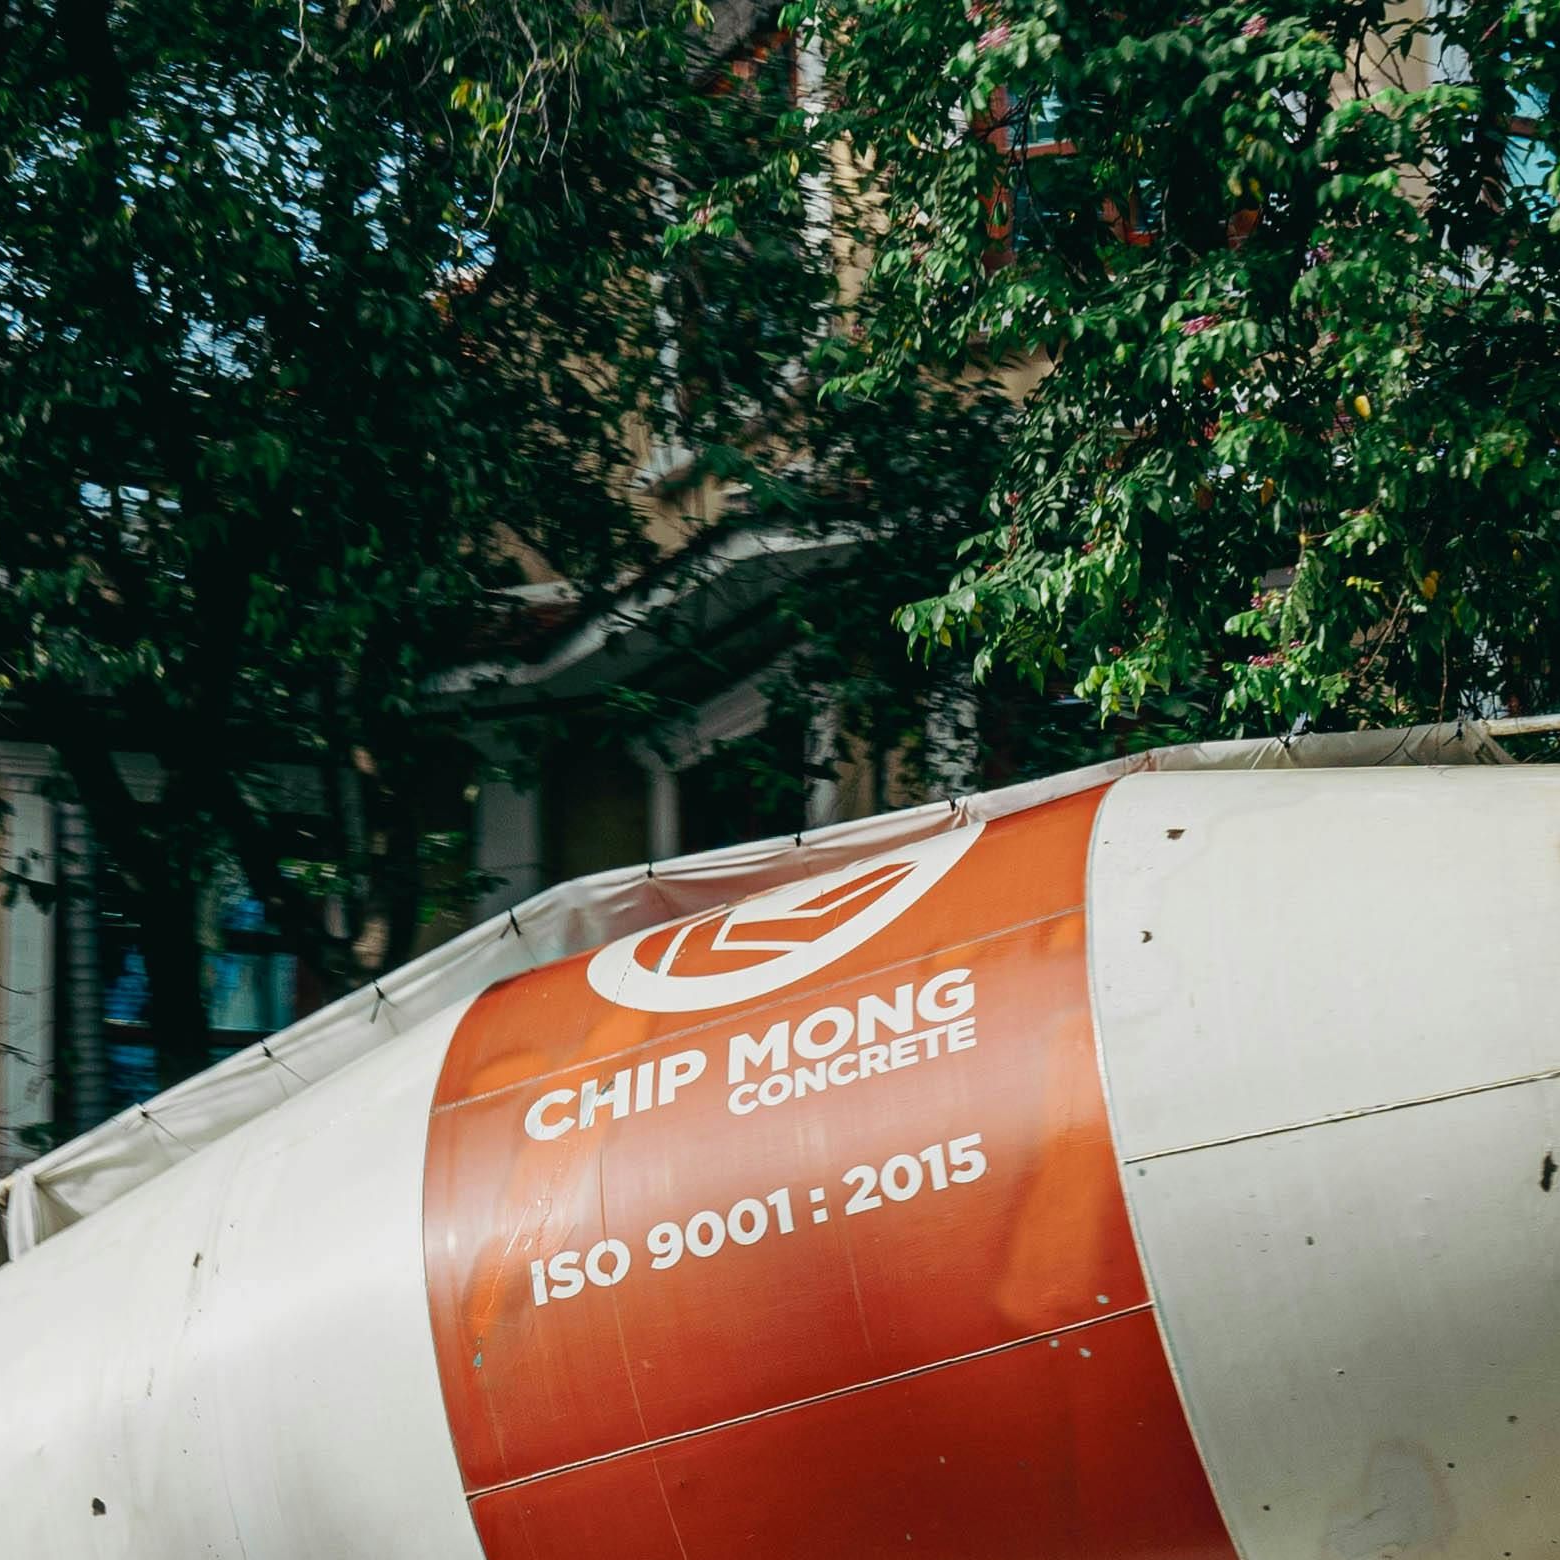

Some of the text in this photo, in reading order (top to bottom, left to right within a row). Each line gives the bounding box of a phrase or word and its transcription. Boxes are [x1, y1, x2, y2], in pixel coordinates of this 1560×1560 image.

[525, 968, 976, 1141] CHIP MONG
[727, 1016, 978, 1117] CONCRETE
[530, 1237, 631, 1306] ISO
[646, 1186, 795, 1270] 9001
[841, 1132, 987, 1216] 2015
